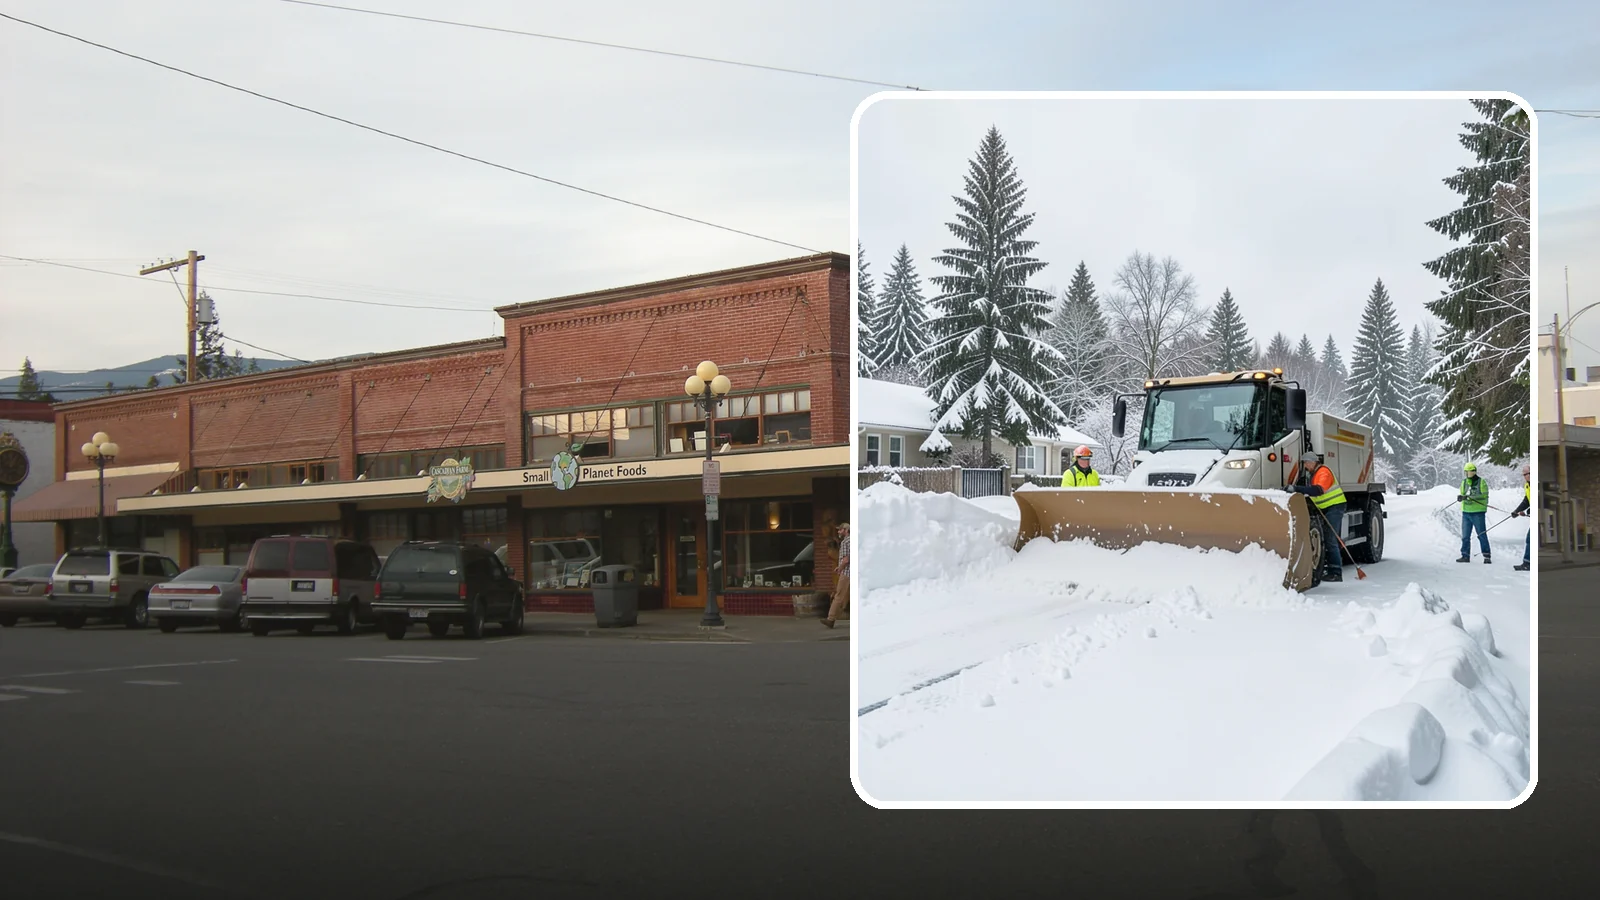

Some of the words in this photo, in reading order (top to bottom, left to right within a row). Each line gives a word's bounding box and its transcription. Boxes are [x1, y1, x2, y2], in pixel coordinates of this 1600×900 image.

[523, 471, 549, 483] Small
[582, 467, 614, 479] Planet
[616, 464, 647, 477] Foods
